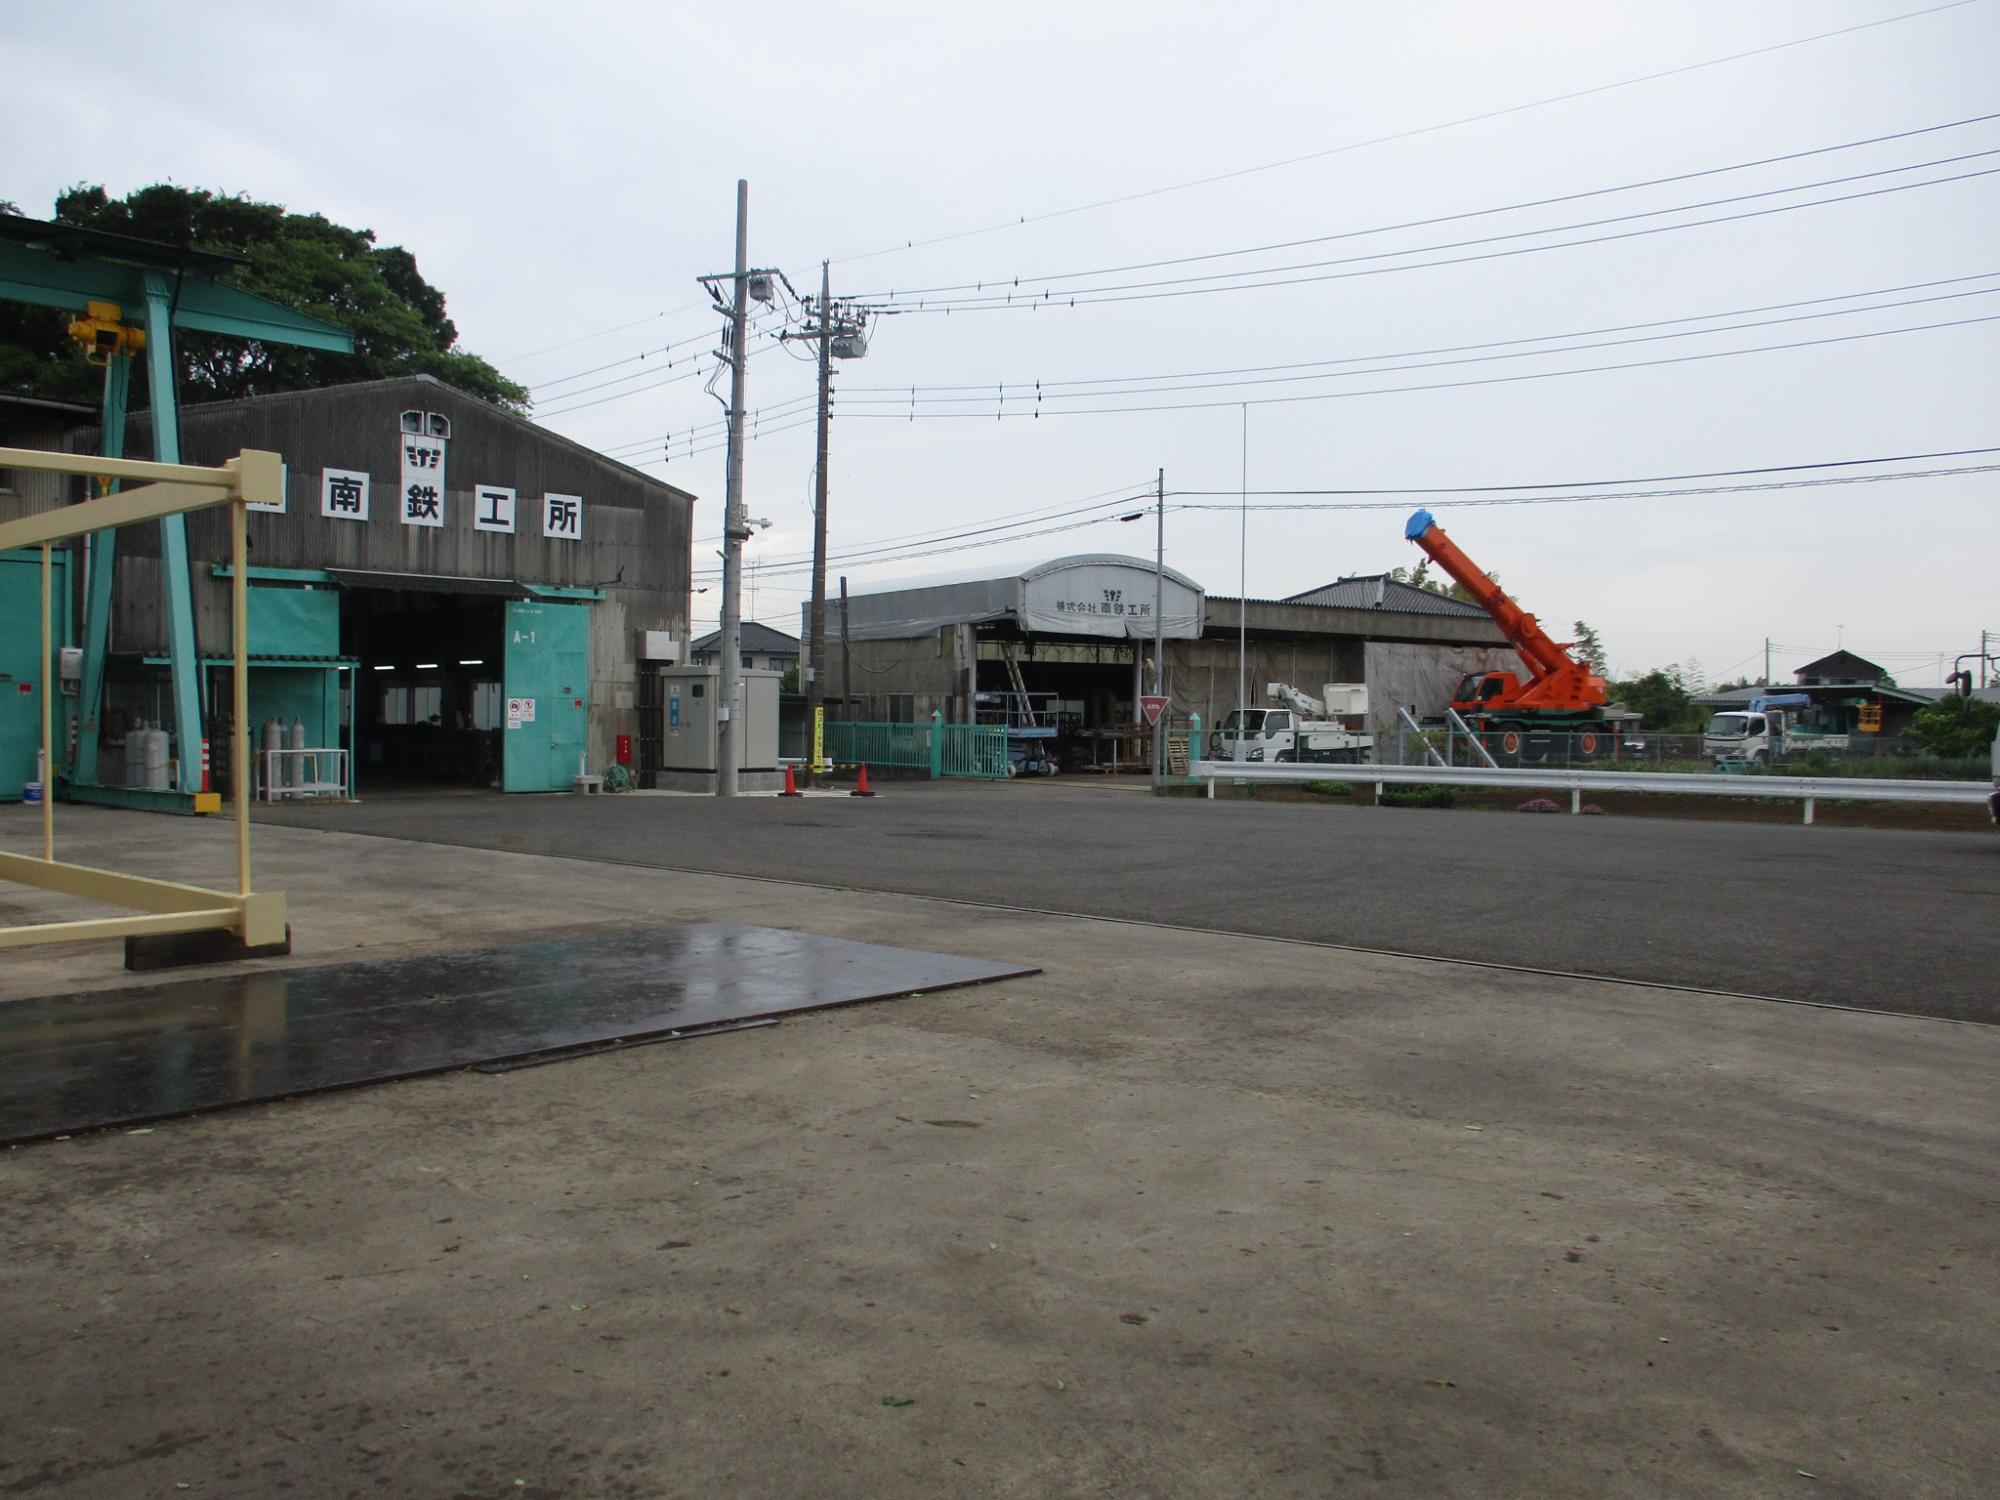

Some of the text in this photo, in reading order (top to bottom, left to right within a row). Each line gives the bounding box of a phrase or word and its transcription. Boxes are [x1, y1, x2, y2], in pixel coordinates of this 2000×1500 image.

[257, 476, 577, 534] 南鉄工所
[513, 630, 535, 644] A-1
